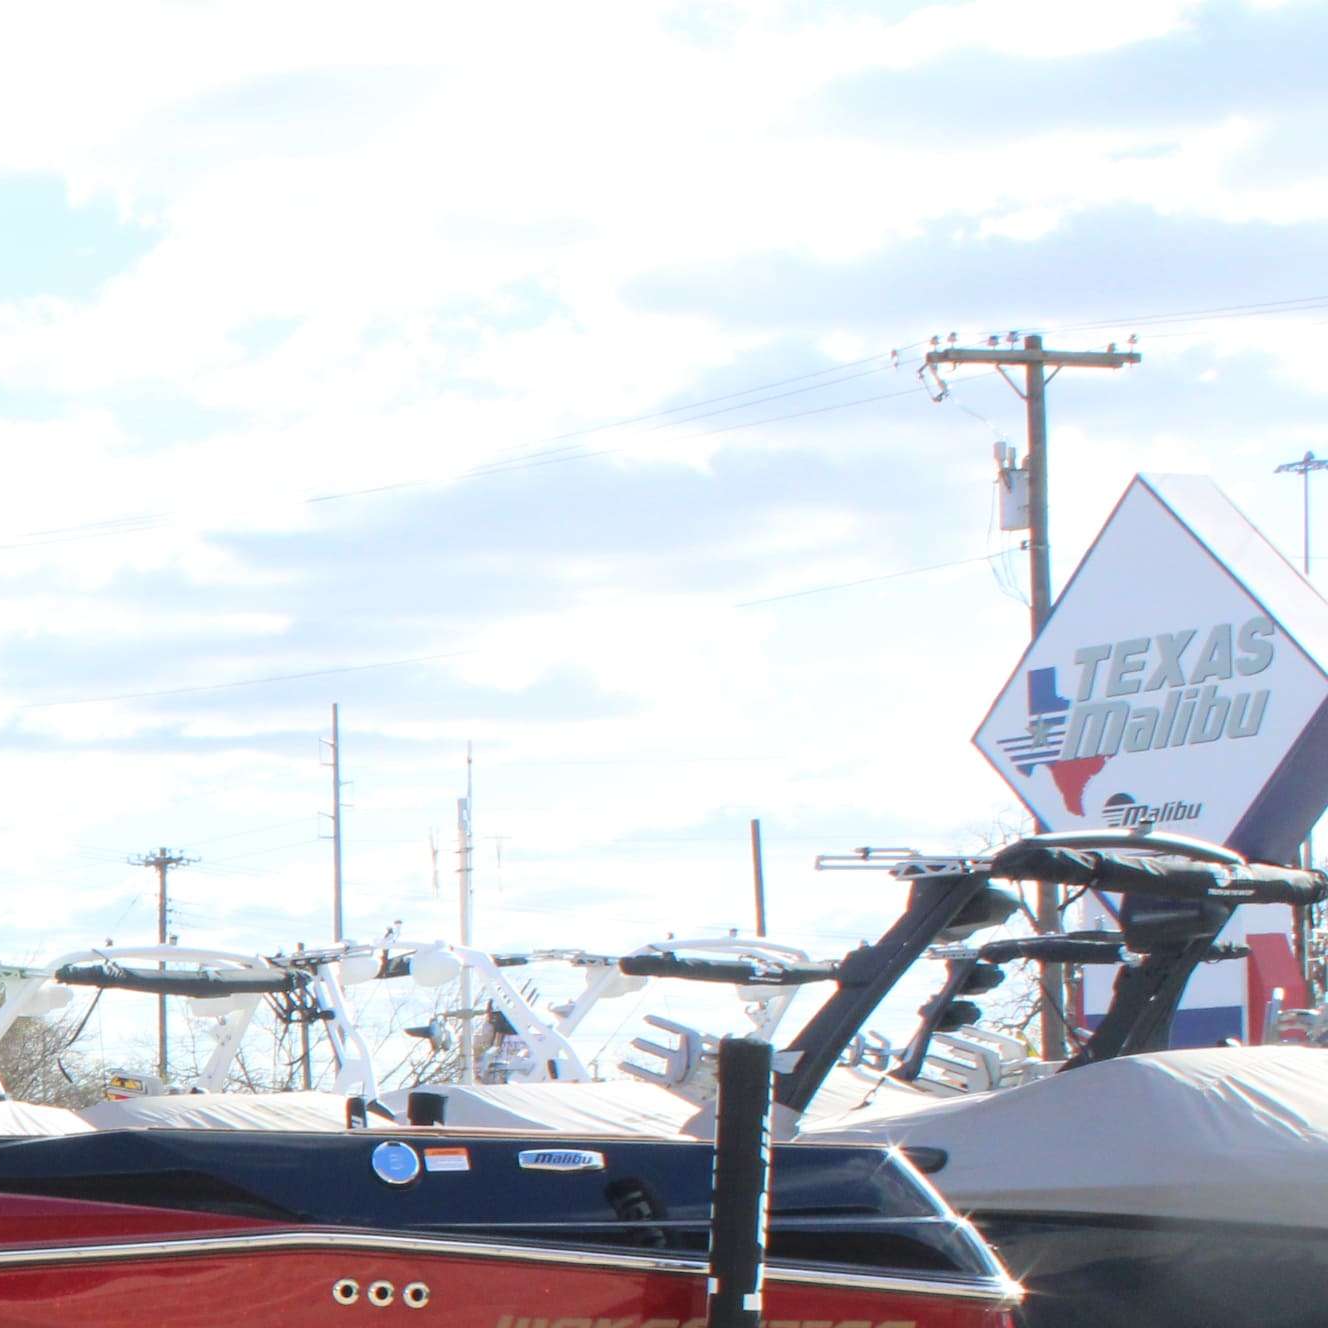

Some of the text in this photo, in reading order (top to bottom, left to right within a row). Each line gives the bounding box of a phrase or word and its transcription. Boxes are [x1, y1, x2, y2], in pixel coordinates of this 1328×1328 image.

[1072, 615, 1276, 703] TEXAS
[1059, 686, 1270, 761] Malibu
[1121, 799, 1204, 828] Malibu
[533, 1151, 594, 1166] Malibu
